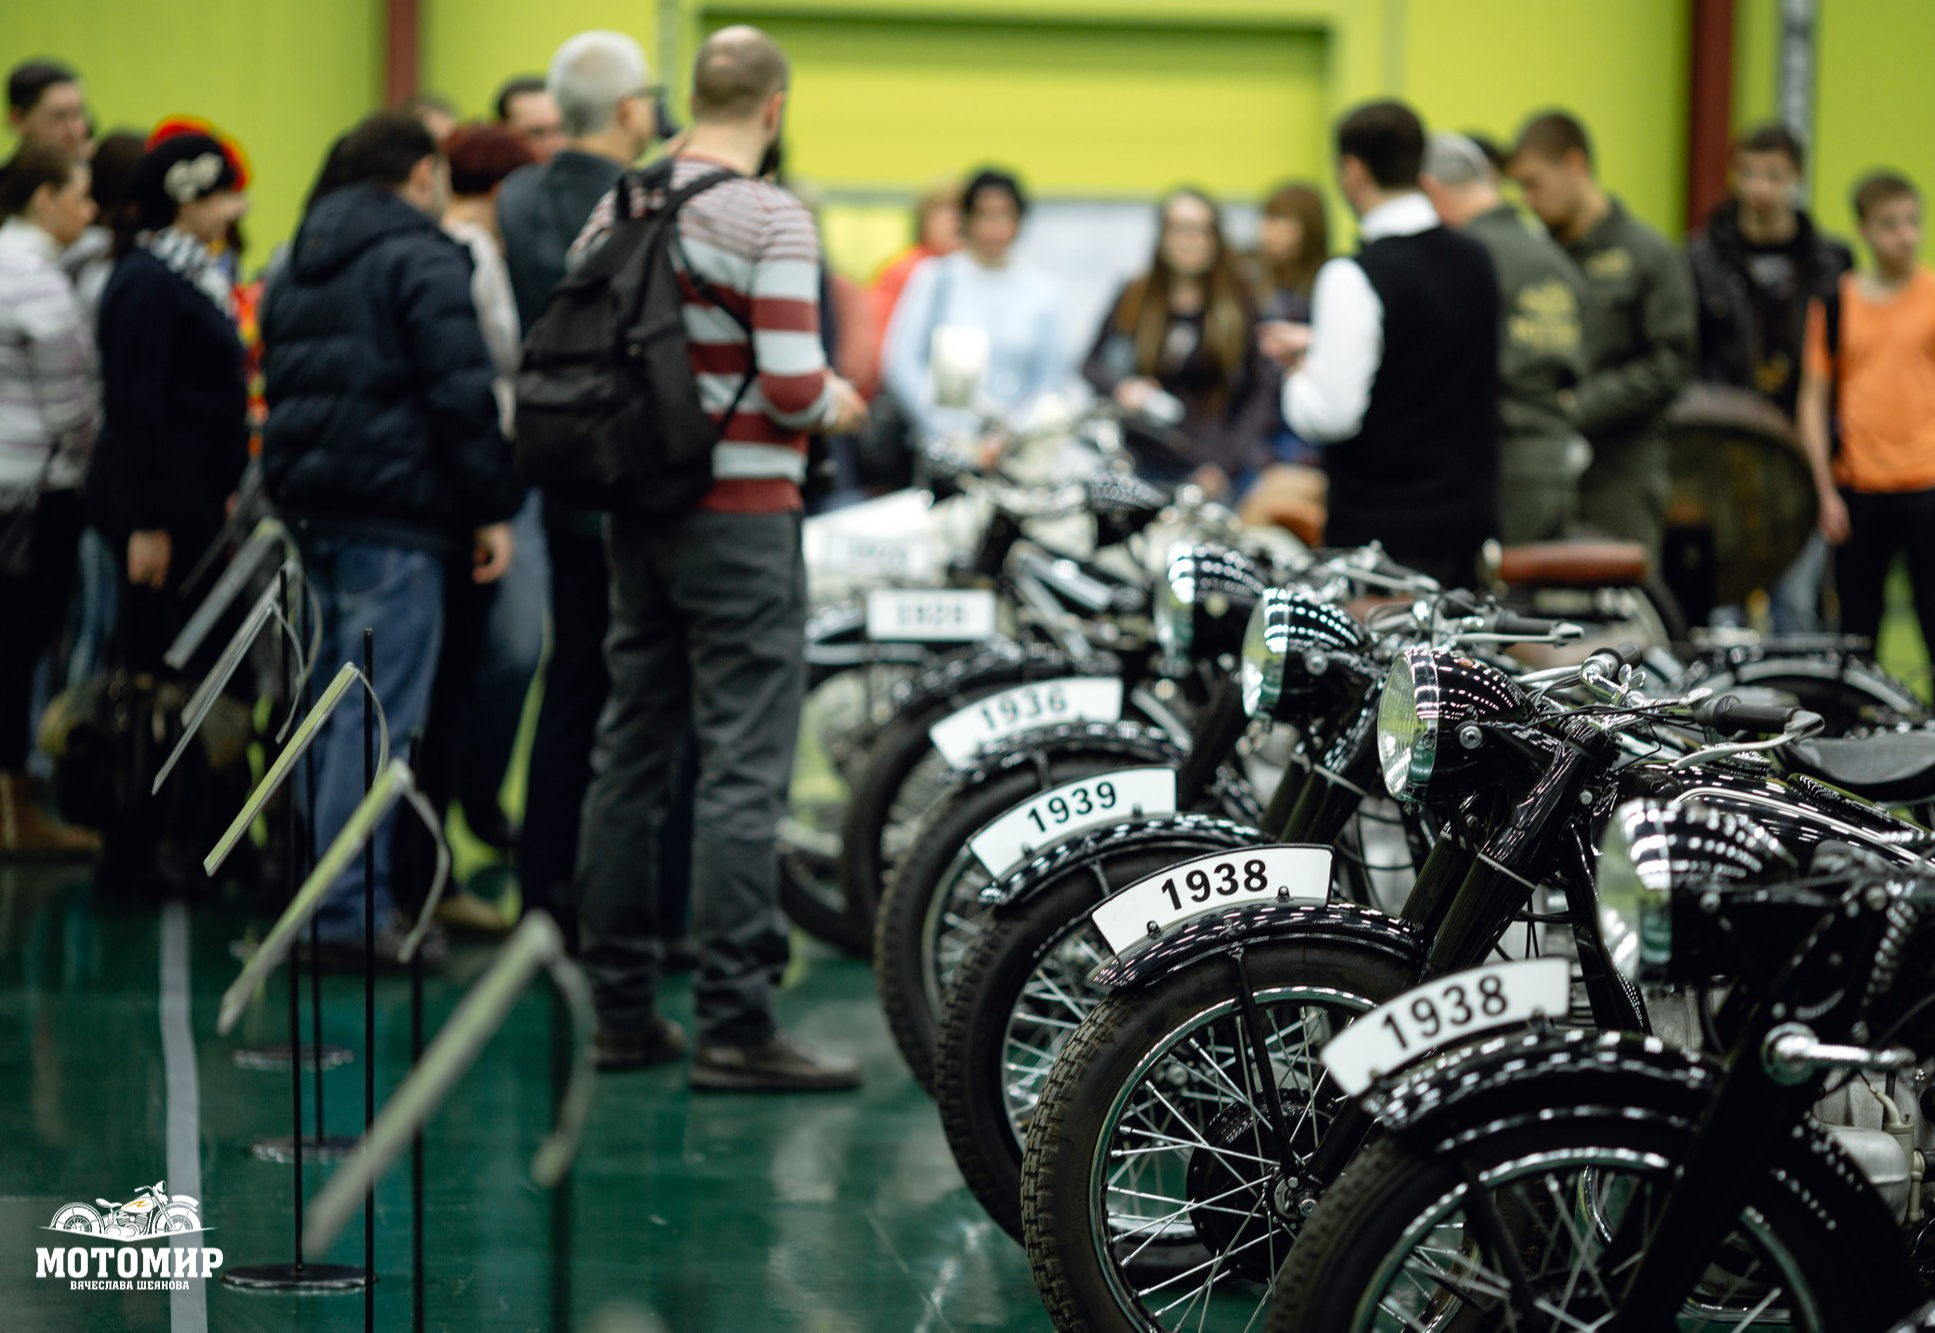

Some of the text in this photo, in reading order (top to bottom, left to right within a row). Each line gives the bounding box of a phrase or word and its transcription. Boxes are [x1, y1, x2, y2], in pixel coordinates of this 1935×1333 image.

[981, 686, 1067, 731] 1936
[1027, 781, 1117, 833] 1939
[1161, 858, 1269, 911] 1938
[1382, 975, 1507, 1049] 1938
